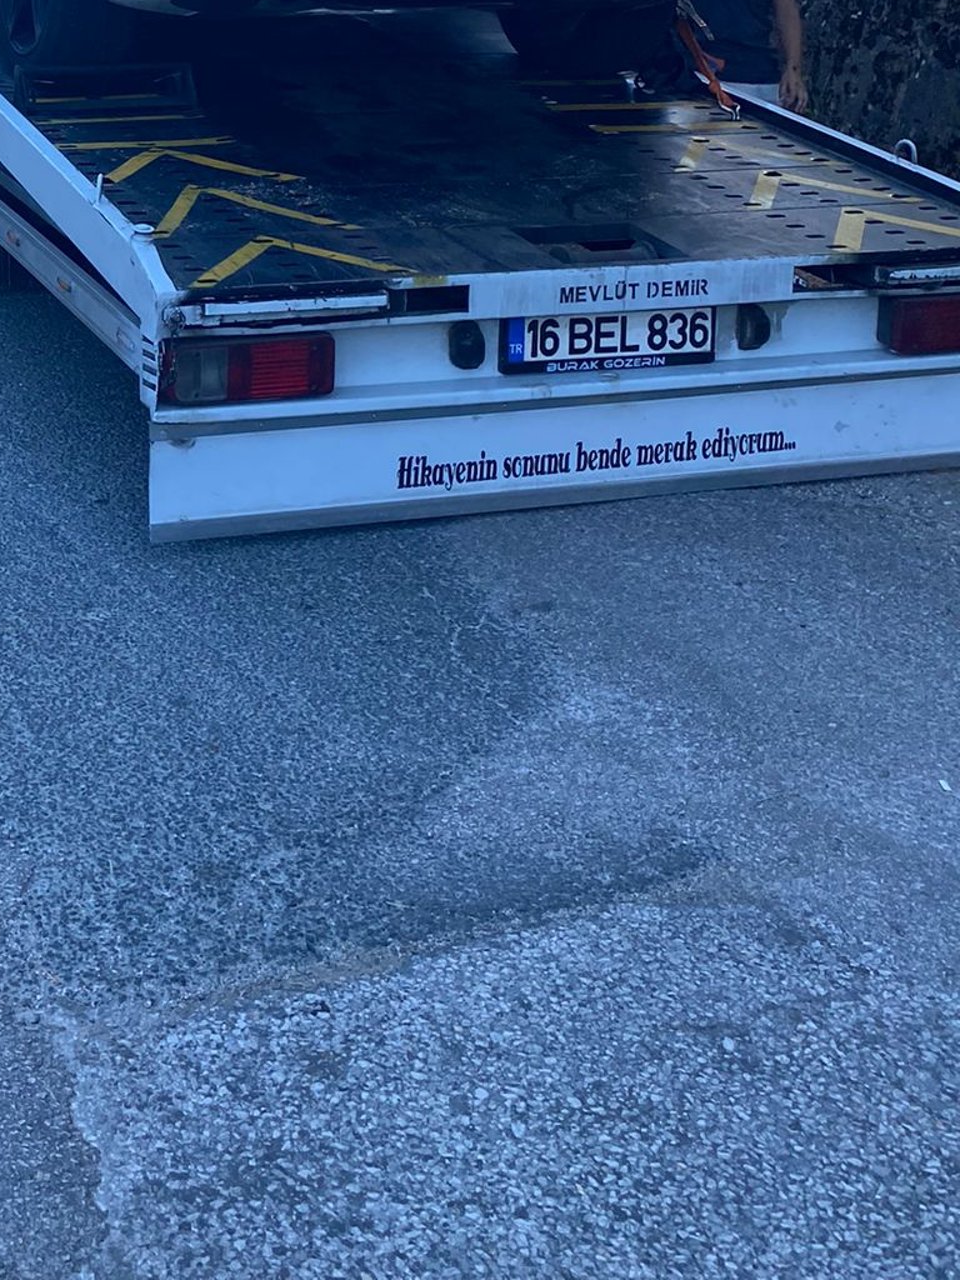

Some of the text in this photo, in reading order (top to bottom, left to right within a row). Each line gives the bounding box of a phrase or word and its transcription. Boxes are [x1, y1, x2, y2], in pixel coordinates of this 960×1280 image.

[560, 280, 640, 304] MEVLÜT
[527, 311, 710, 359] 16 BEL 836
[509, 343, 523, 355] TR
[546, 359, 600, 372] BURAK
[397, 451, 498, 492] Hikayenin
[502, 452, 570, 479] sonunu
[576, 438, 631, 472] bende
[636, 431, 697, 466] merak
